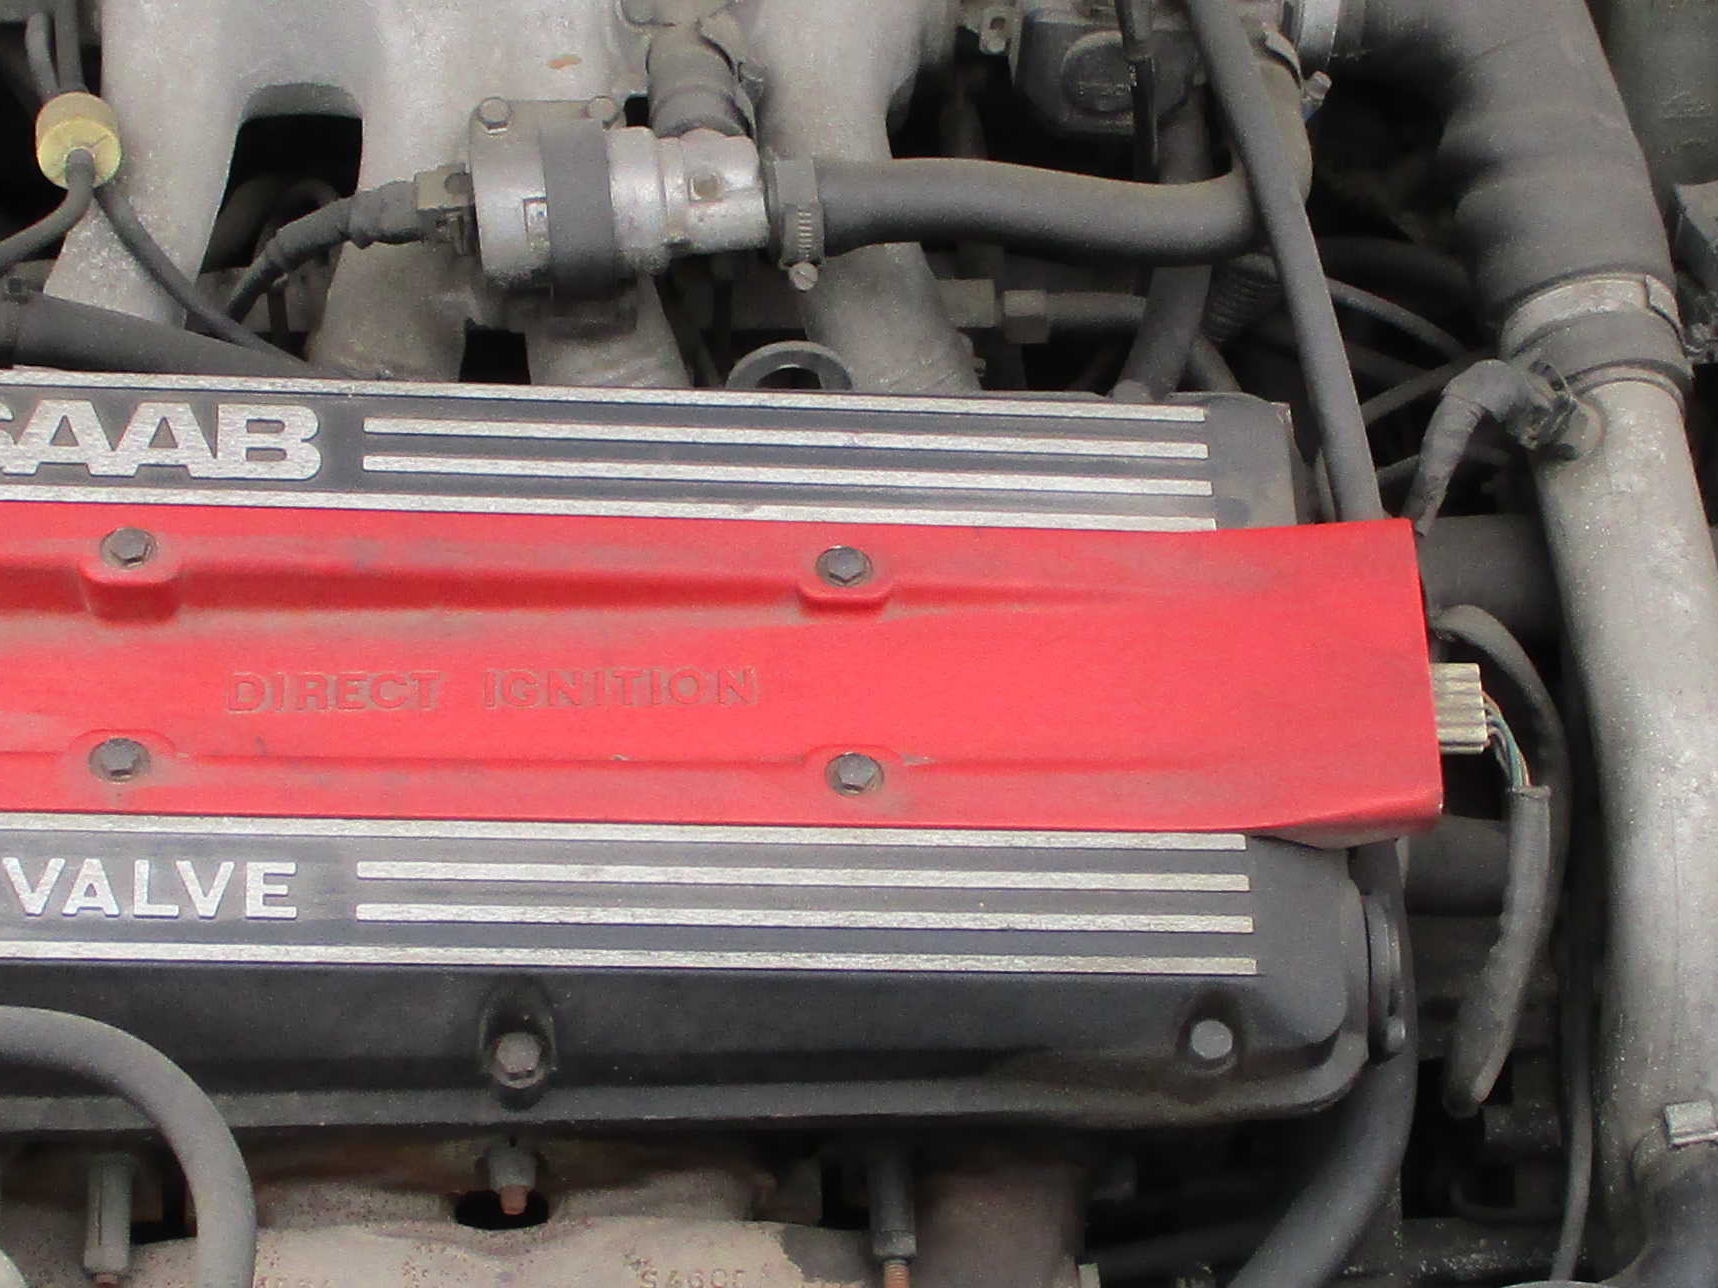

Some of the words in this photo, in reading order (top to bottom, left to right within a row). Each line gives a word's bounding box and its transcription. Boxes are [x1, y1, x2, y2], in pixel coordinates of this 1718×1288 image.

[227, 670, 442, 712] DIRECT
[484, 665, 759, 708] IGNITION
[1, 856, 299, 920] VALVE
